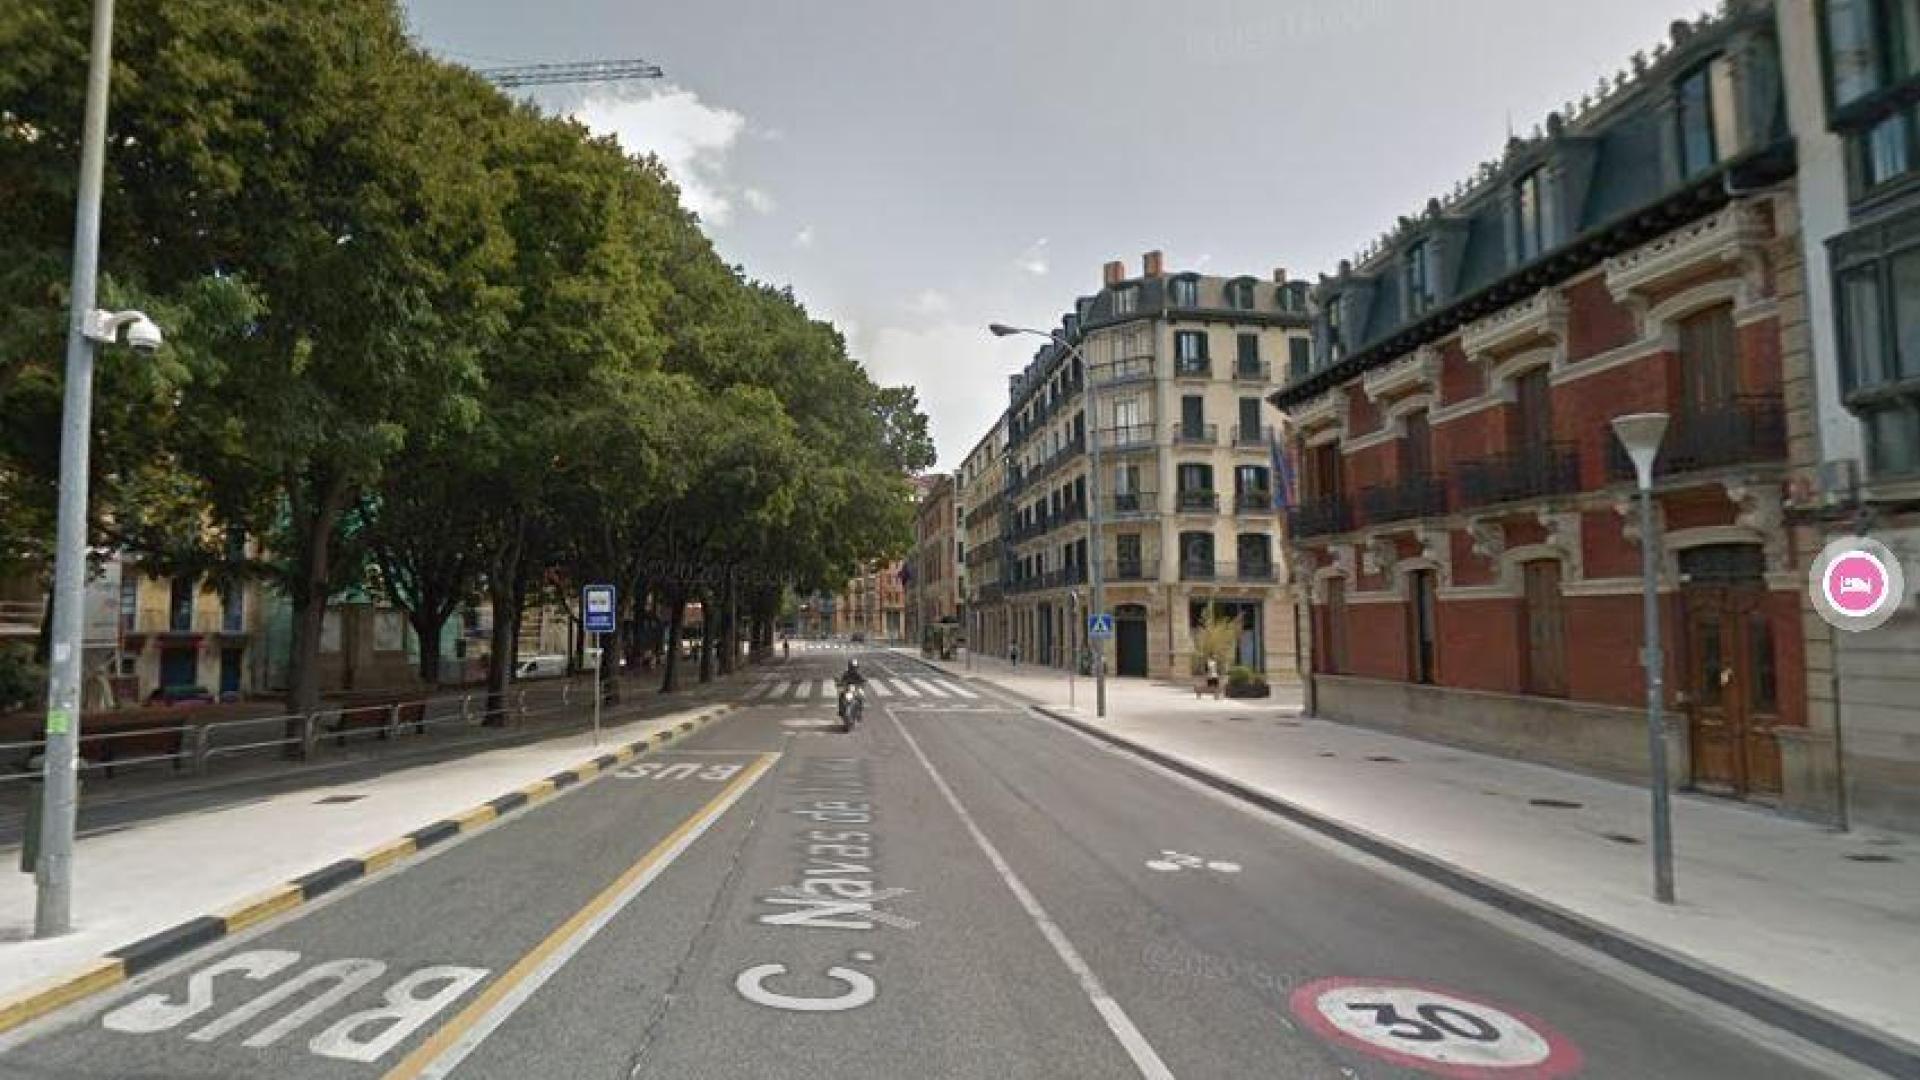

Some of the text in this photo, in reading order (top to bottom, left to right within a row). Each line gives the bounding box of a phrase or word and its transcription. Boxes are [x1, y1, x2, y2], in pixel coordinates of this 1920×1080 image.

[614, 762, 743, 779] BUS
[102, 949, 491, 1063] BUS
[1346, 1002, 1501, 1043] 30
